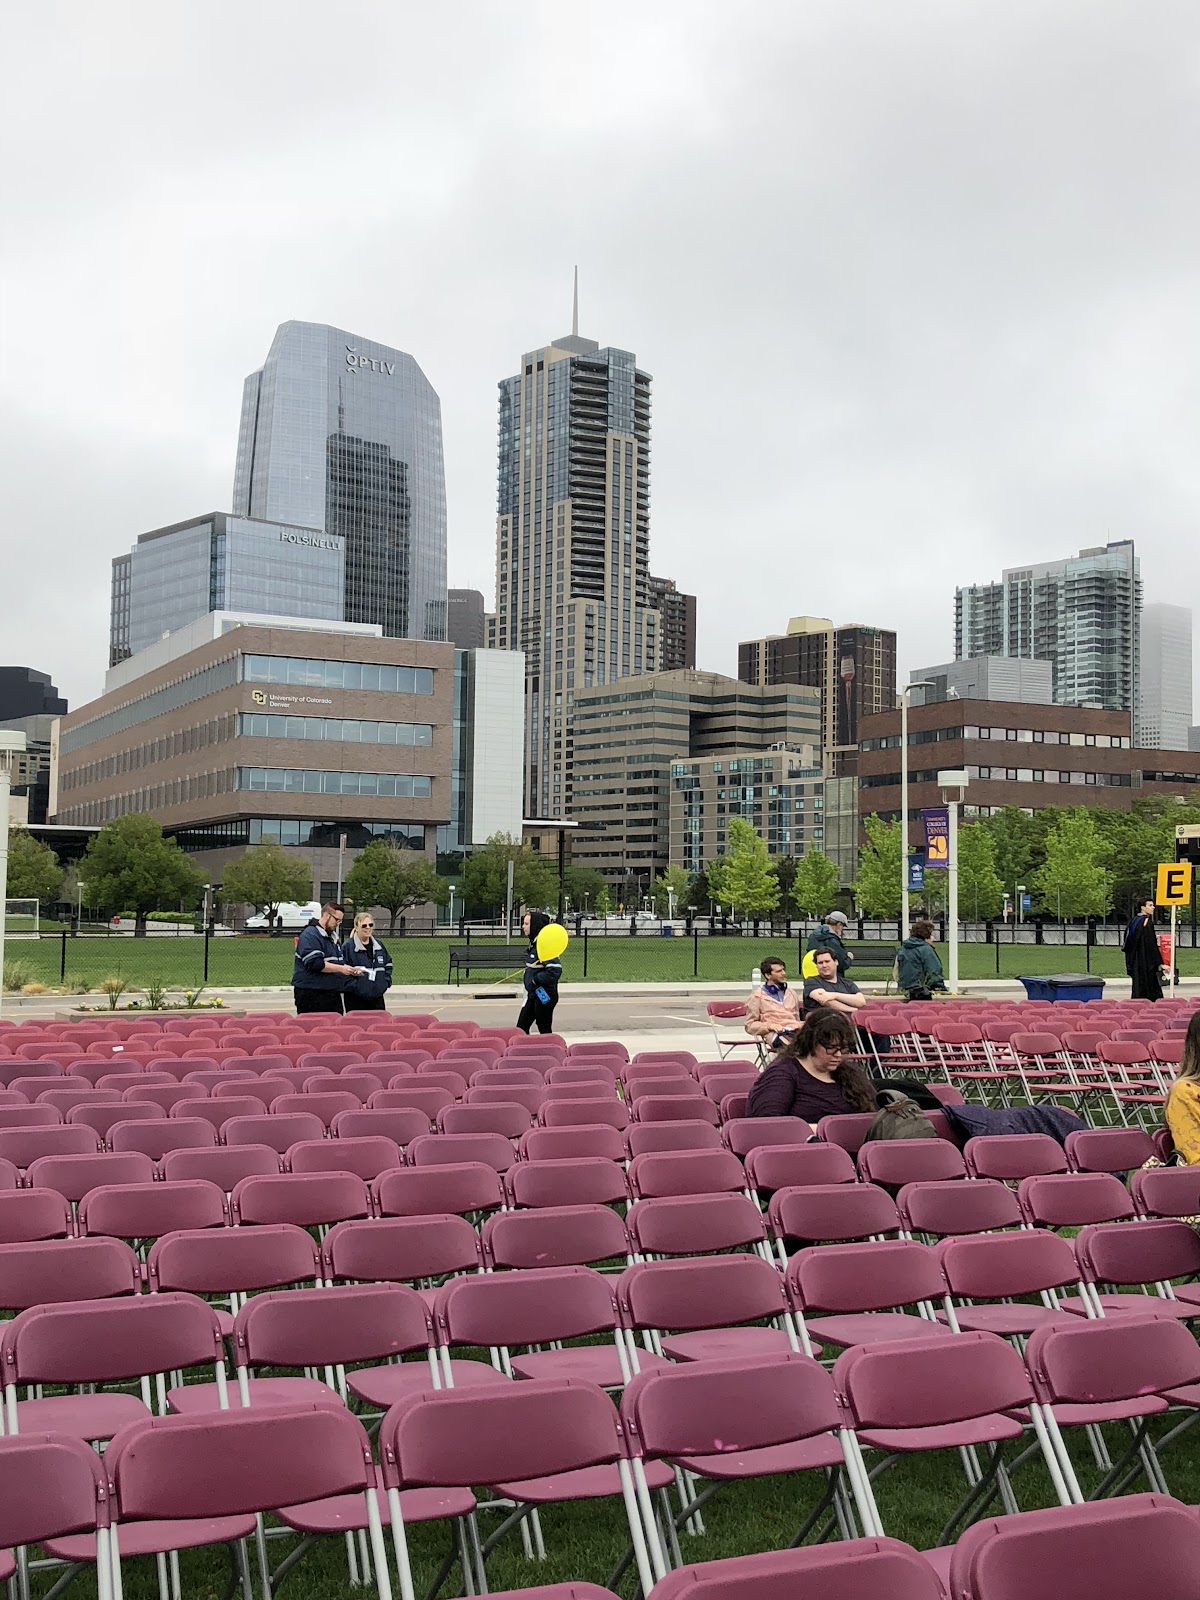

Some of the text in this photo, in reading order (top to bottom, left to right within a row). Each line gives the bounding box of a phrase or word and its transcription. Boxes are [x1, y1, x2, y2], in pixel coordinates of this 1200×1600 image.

[346, 351, 395, 375] OPTIV
[280, 532, 341, 551] POLSINELLI
[1166, 870, 1185, 898] E
